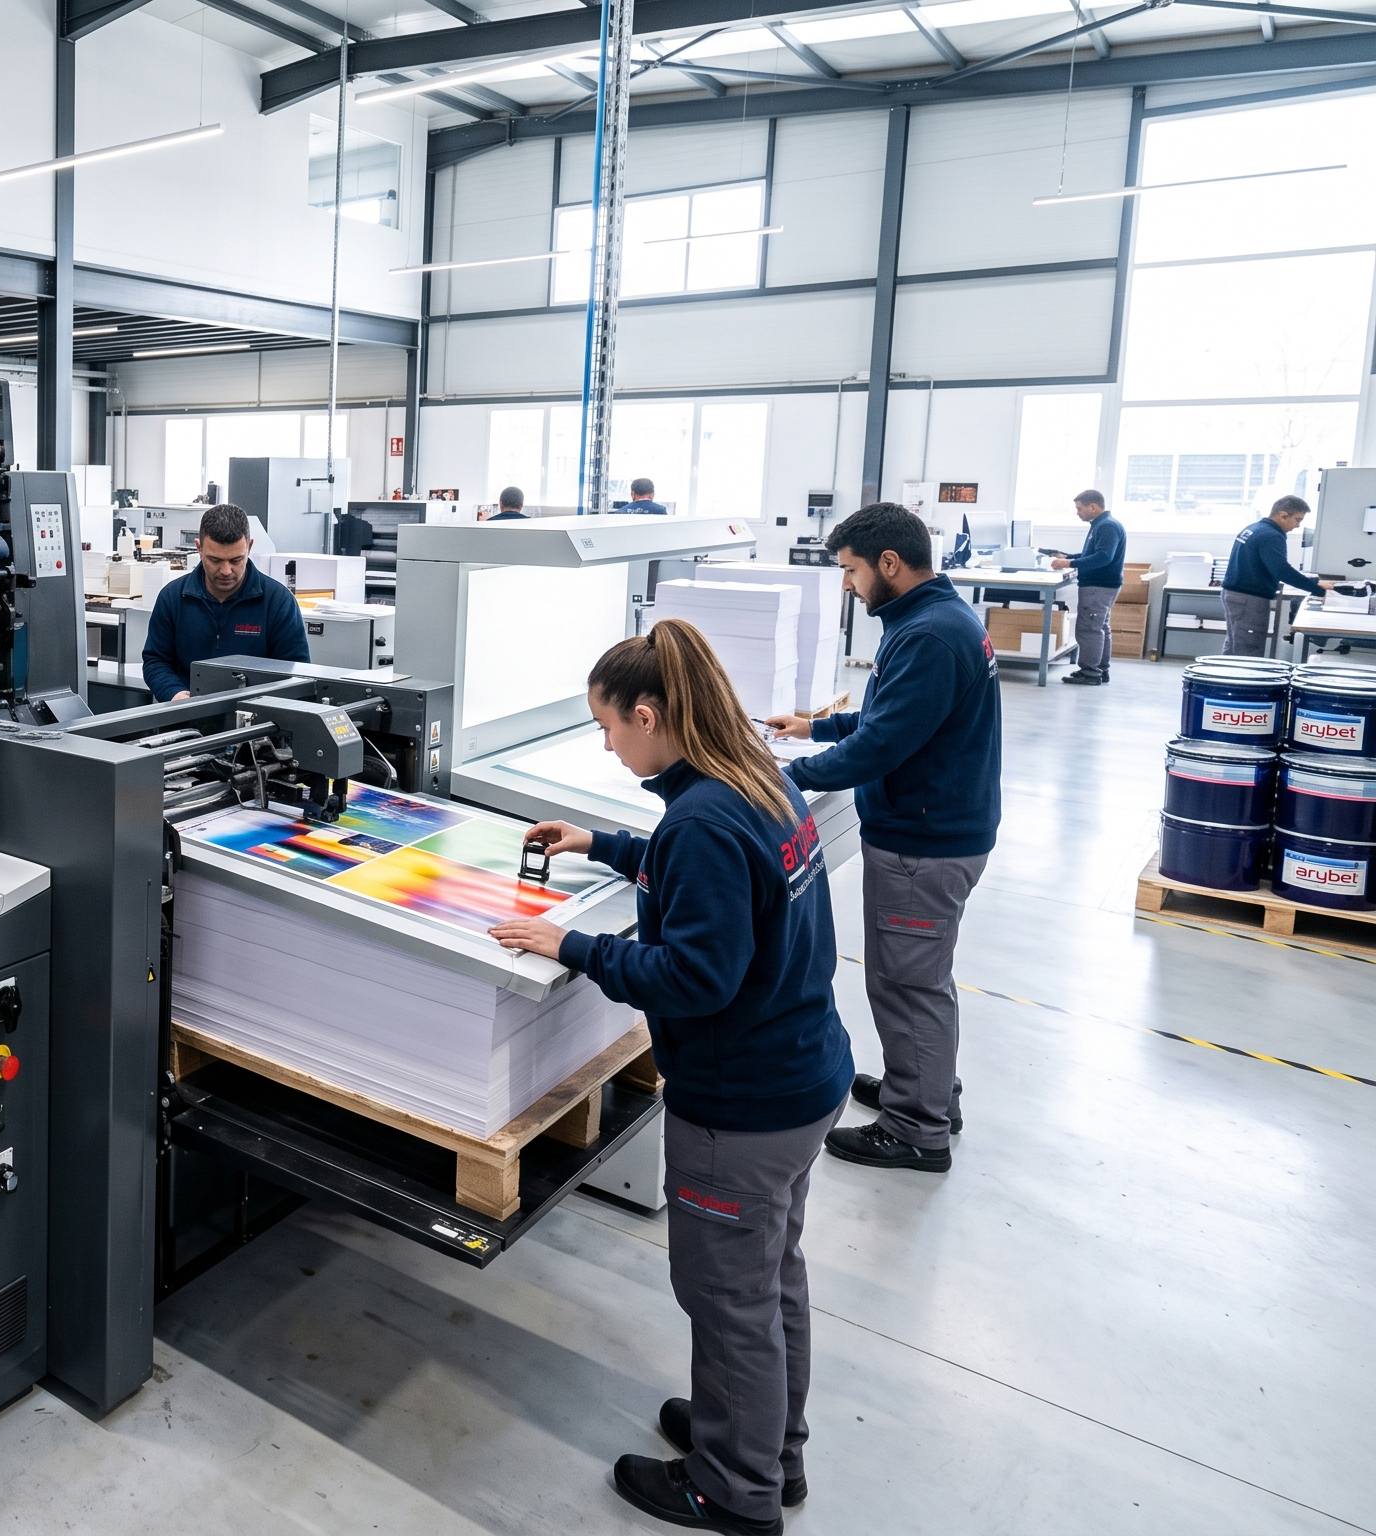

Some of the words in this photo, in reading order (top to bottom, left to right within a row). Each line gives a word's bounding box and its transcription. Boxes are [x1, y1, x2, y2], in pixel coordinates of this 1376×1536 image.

[1212, 711, 1268, 725] arybet
[1301, 722, 1357, 738] arybet
[1296, 866, 1358, 884] arybet
[678, 1186, 741, 1215] arybet
